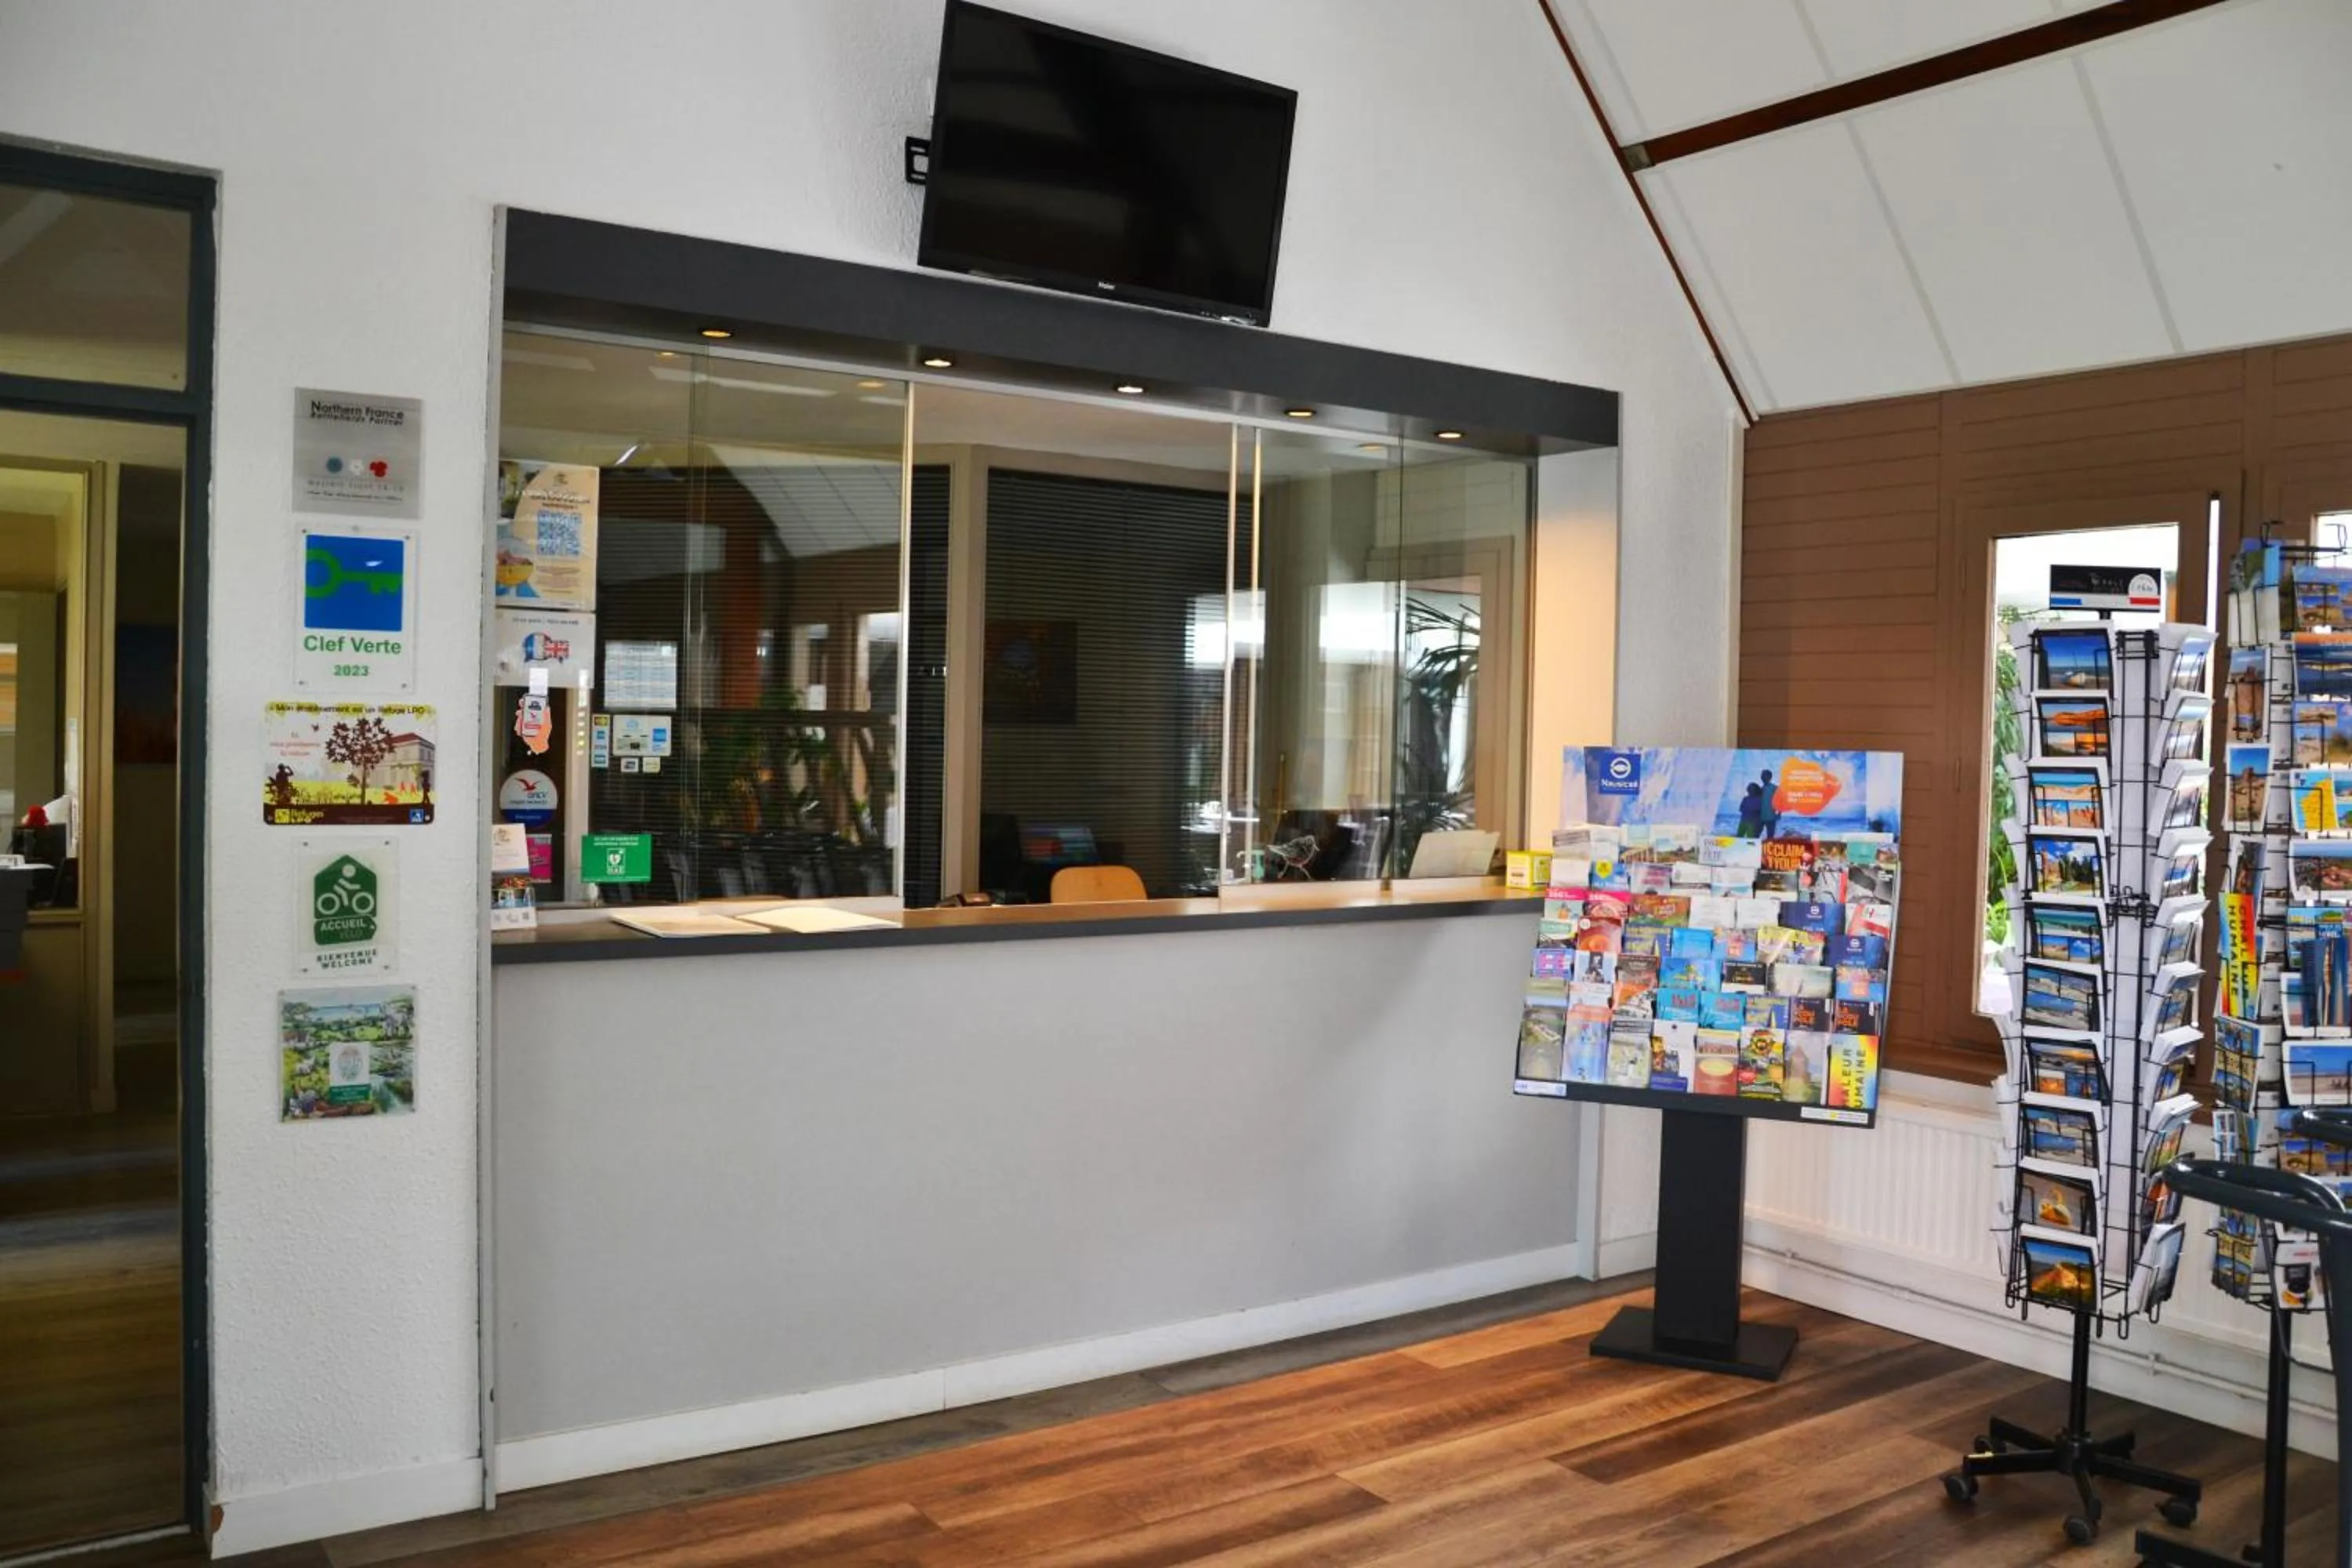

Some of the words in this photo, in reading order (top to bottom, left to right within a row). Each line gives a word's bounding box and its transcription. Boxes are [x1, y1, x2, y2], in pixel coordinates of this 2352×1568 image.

[310, 400, 363, 415] Northern
[365, 406, 405, 419] France
[303, 635, 346, 652] Clef
[350, 637, 401, 654] Verte
[333, 664, 369, 677] 2023
[320, 918, 366, 931] ACCUEIL
[317, 949, 377, 963] BIENVENUE
[2228, 906, 2239, 996] HUMAINE
[321, 957, 372, 969] WELCOME
[1853, 1049, 1866, 1108] UMAINE
